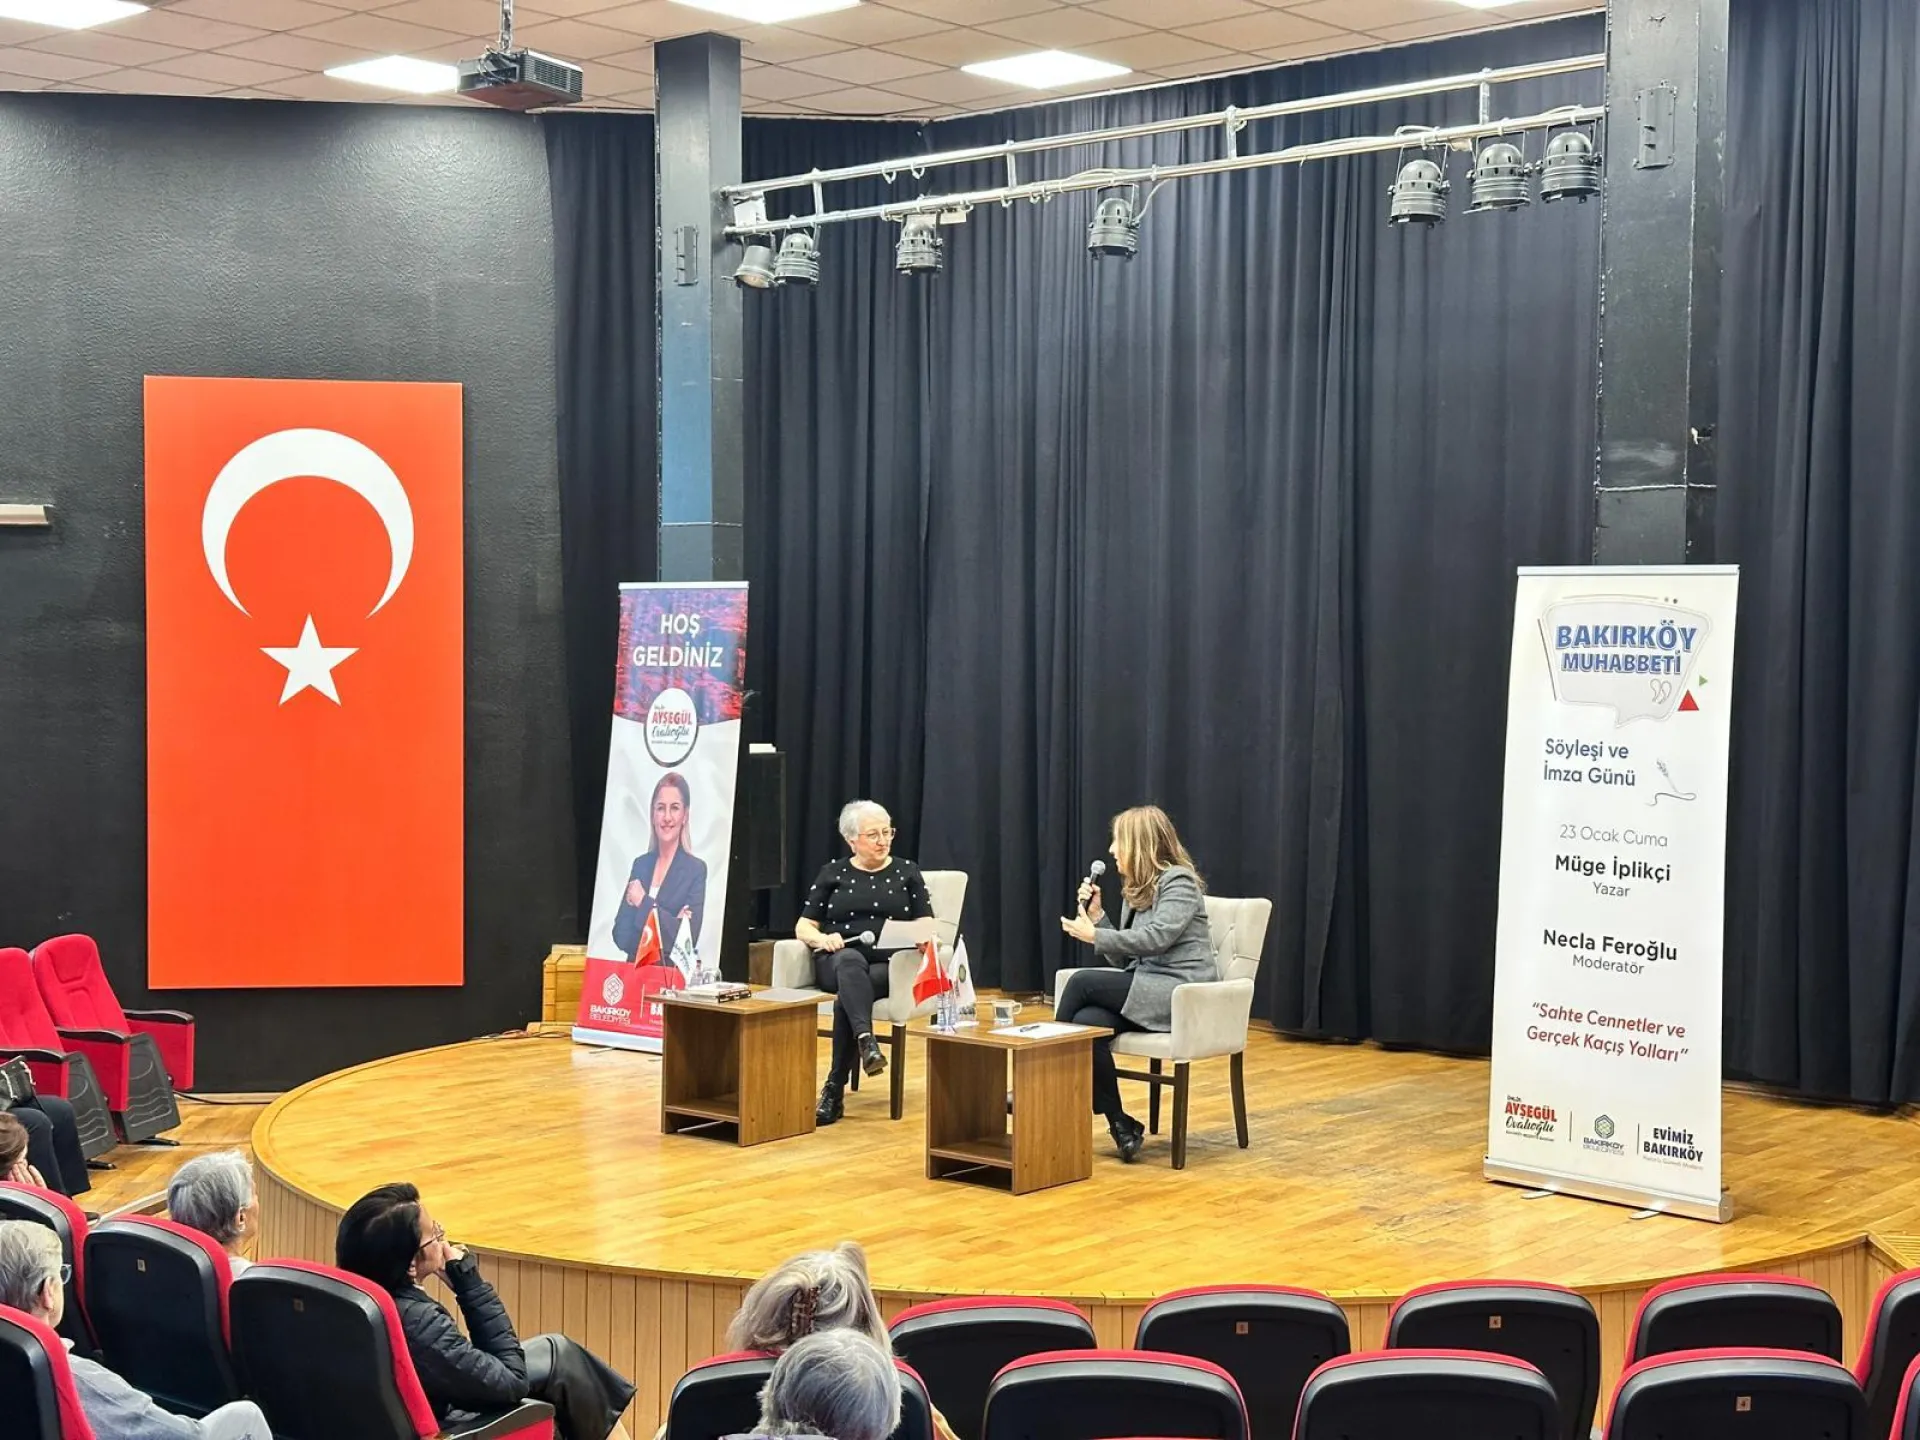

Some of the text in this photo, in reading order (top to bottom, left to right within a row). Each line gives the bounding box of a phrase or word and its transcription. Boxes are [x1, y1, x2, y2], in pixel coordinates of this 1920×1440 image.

[660, 613, 700, 638] HOŞ
[1555, 619, 1697, 653] BAKIRKÖY
[632, 642, 724, 668] GELDİNİZ
[1560, 650, 1682, 675] MUHABBETİ
[1545, 738, 1629, 761] Söyleşi ve
[1543, 760, 1636, 786] İmza Günü
[1559, 824, 1668, 847] 23 Ocak Cuma
[1555, 854, 1671, 883] Müge İplikçi
[1592, 881, 1630, 897] Yazar
[1543, 929, 1677, 961] Necla Feroğlu
[1572, 954, 1644, 974] Moderatör
[1587, 1010, 1663, 1035] Cennetler
[1667, 1024, 1685, 1038] ve
[1527, 1025, 1580, 1047] Gerçek
[1583, 1033, 1625, 1056] Kaçış
[1653, 1127, 1693, 1145] EVİMİZ
[1643, 1141, 1703, 1162] BAKIRKÖY
